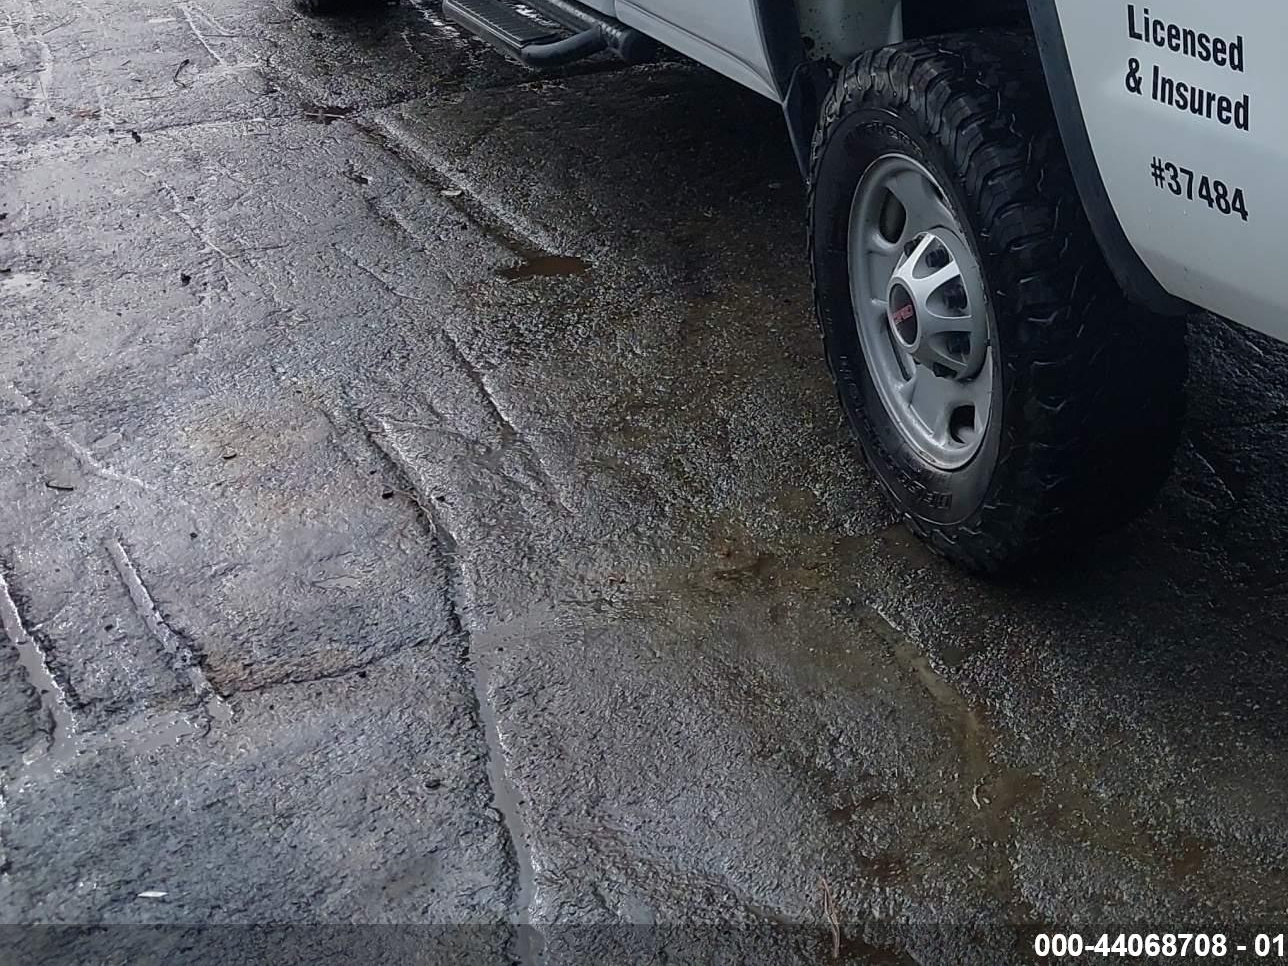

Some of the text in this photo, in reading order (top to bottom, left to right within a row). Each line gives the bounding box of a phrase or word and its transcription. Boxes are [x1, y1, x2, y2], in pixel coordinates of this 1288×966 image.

[1127, 3, 1244, 73] Licensed
[1125, 57, 1250, 132] & Insured
[1150, 156, 1249, 222] #37484
